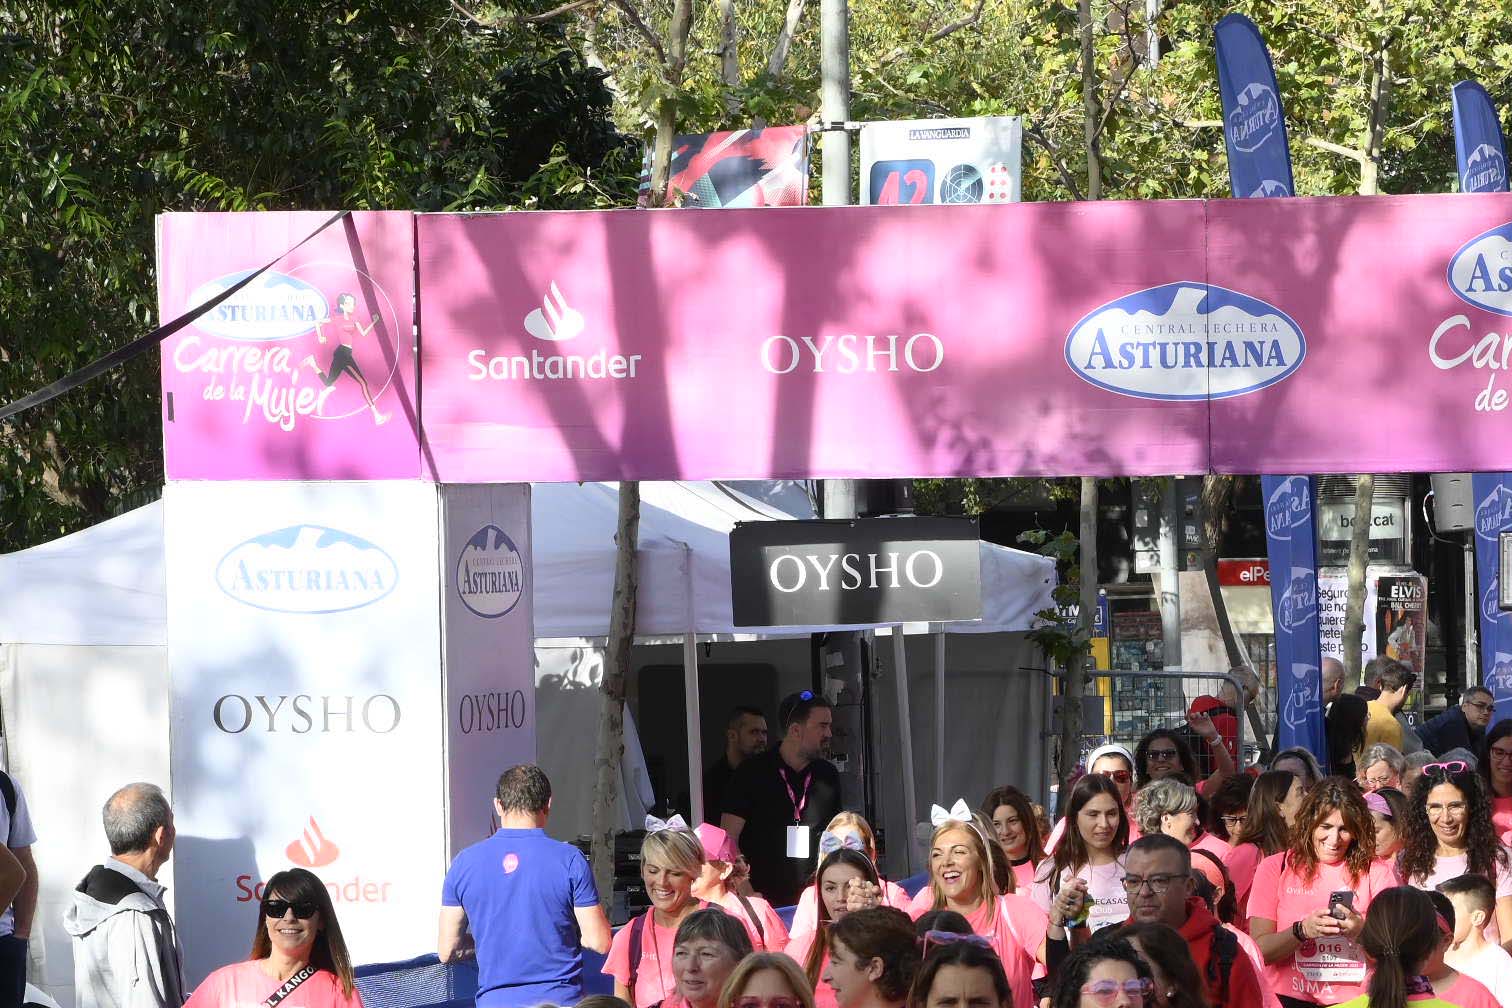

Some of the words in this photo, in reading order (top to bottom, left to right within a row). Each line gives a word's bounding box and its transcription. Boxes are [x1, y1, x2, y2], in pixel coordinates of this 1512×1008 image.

[1121, 320, 1197, 335] CENTRAL
[1203, 320, 1280, 334] LECHERA
[173, 336, 293, 374] Carrera
[468, 349, 641, 381] Santander
[761, 332, 945, 375] OYSHO
[1084, 328, 1287, 373] ASTURIANA
[203, 378, 226, 401] de
[230, 377, 247, 401] la
[243, 368, 337, 432] Mujer
[1474, 373, 1510, 411] de
[231, 559, 387, 593] ASTURIANA
[462, 562, 524, 595] ASTURIANA
[769, 550, 944, 593] OYSHO
[1391, 585, 1422, 598] ELVIS
[213, 693, 403, 734] OYSHO
[459, 689, 526, 735] OYSHO
[1319, 943, 1342, 953] 016
[1292, 976, 1333, 995] SUMA
